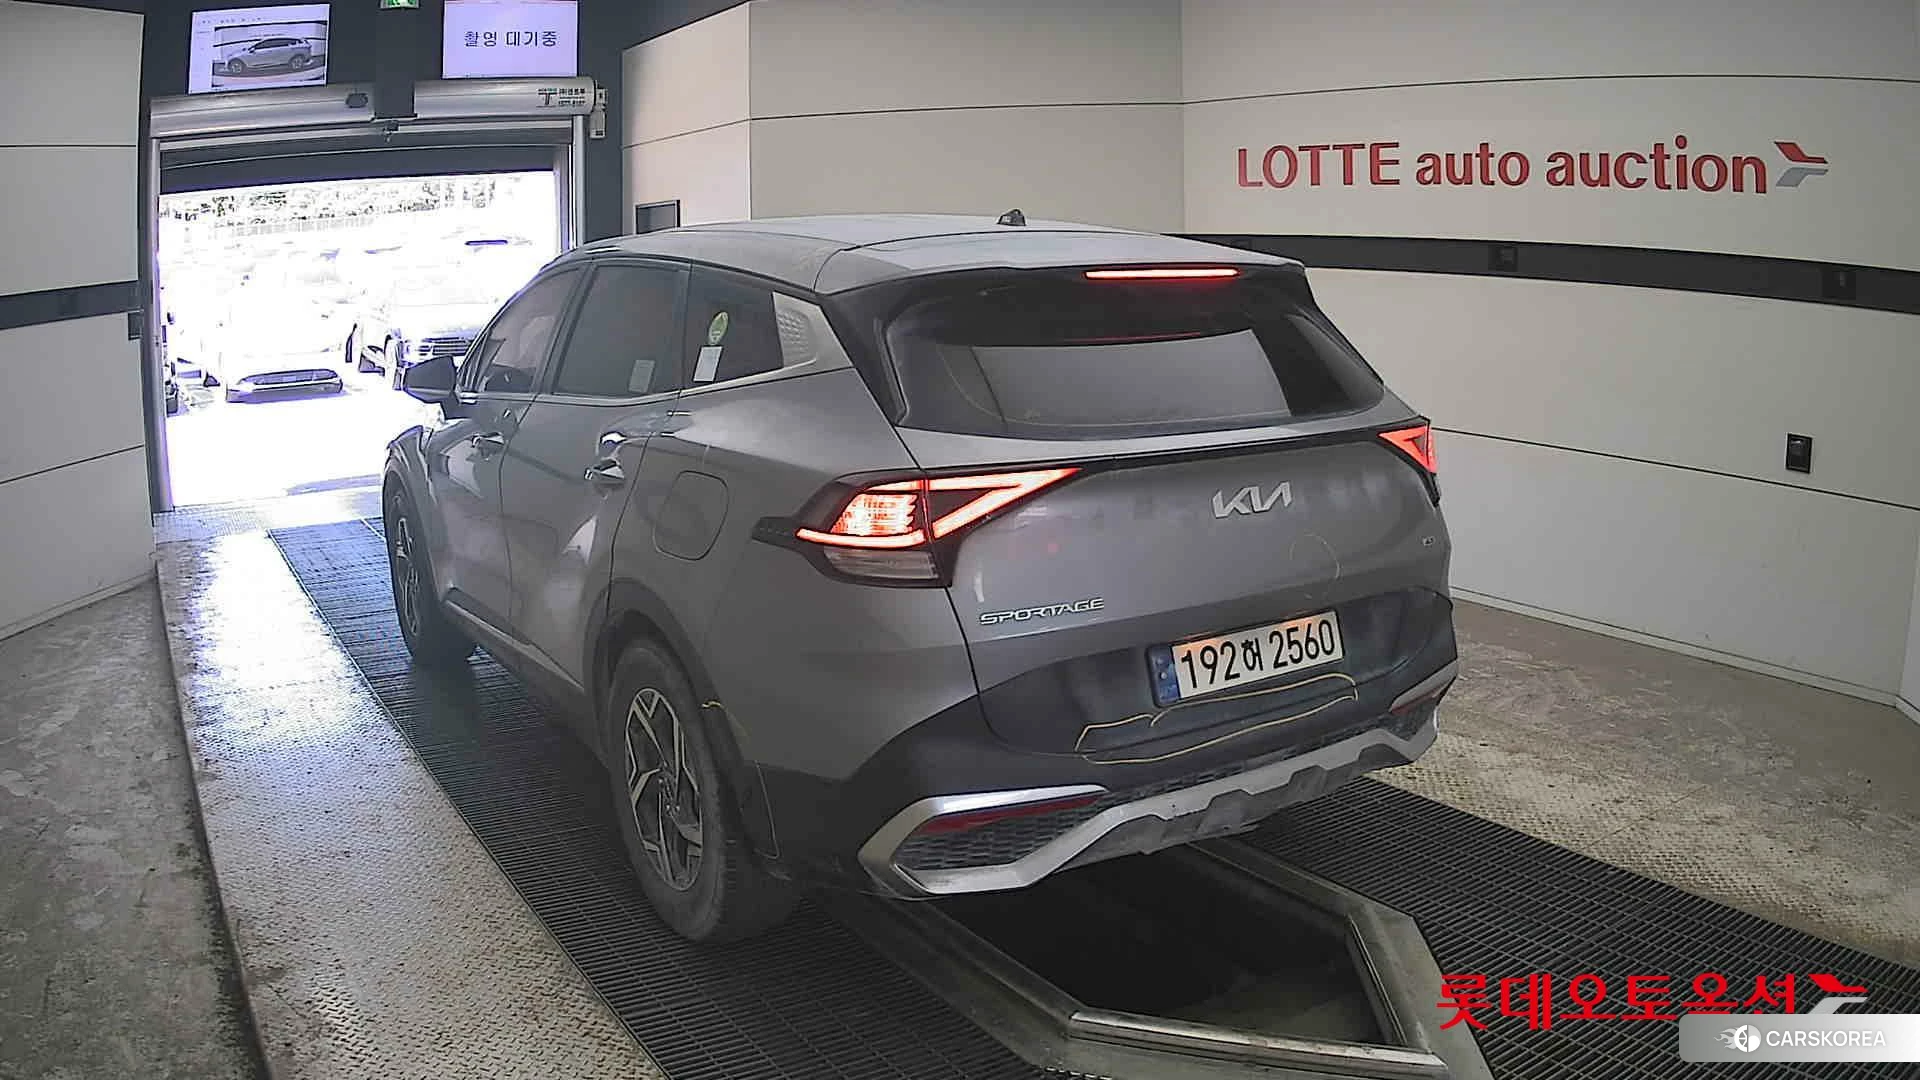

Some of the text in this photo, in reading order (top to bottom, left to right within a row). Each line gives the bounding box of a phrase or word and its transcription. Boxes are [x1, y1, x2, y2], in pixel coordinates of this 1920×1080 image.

[464, 31, 497, 47] 촬영
[1237, 135, 1768, 194] LOTTE auto auction
[980, 597, 1105, 626] SPORTAGE
[1181, 620, 1336, 689] 192허 2560
